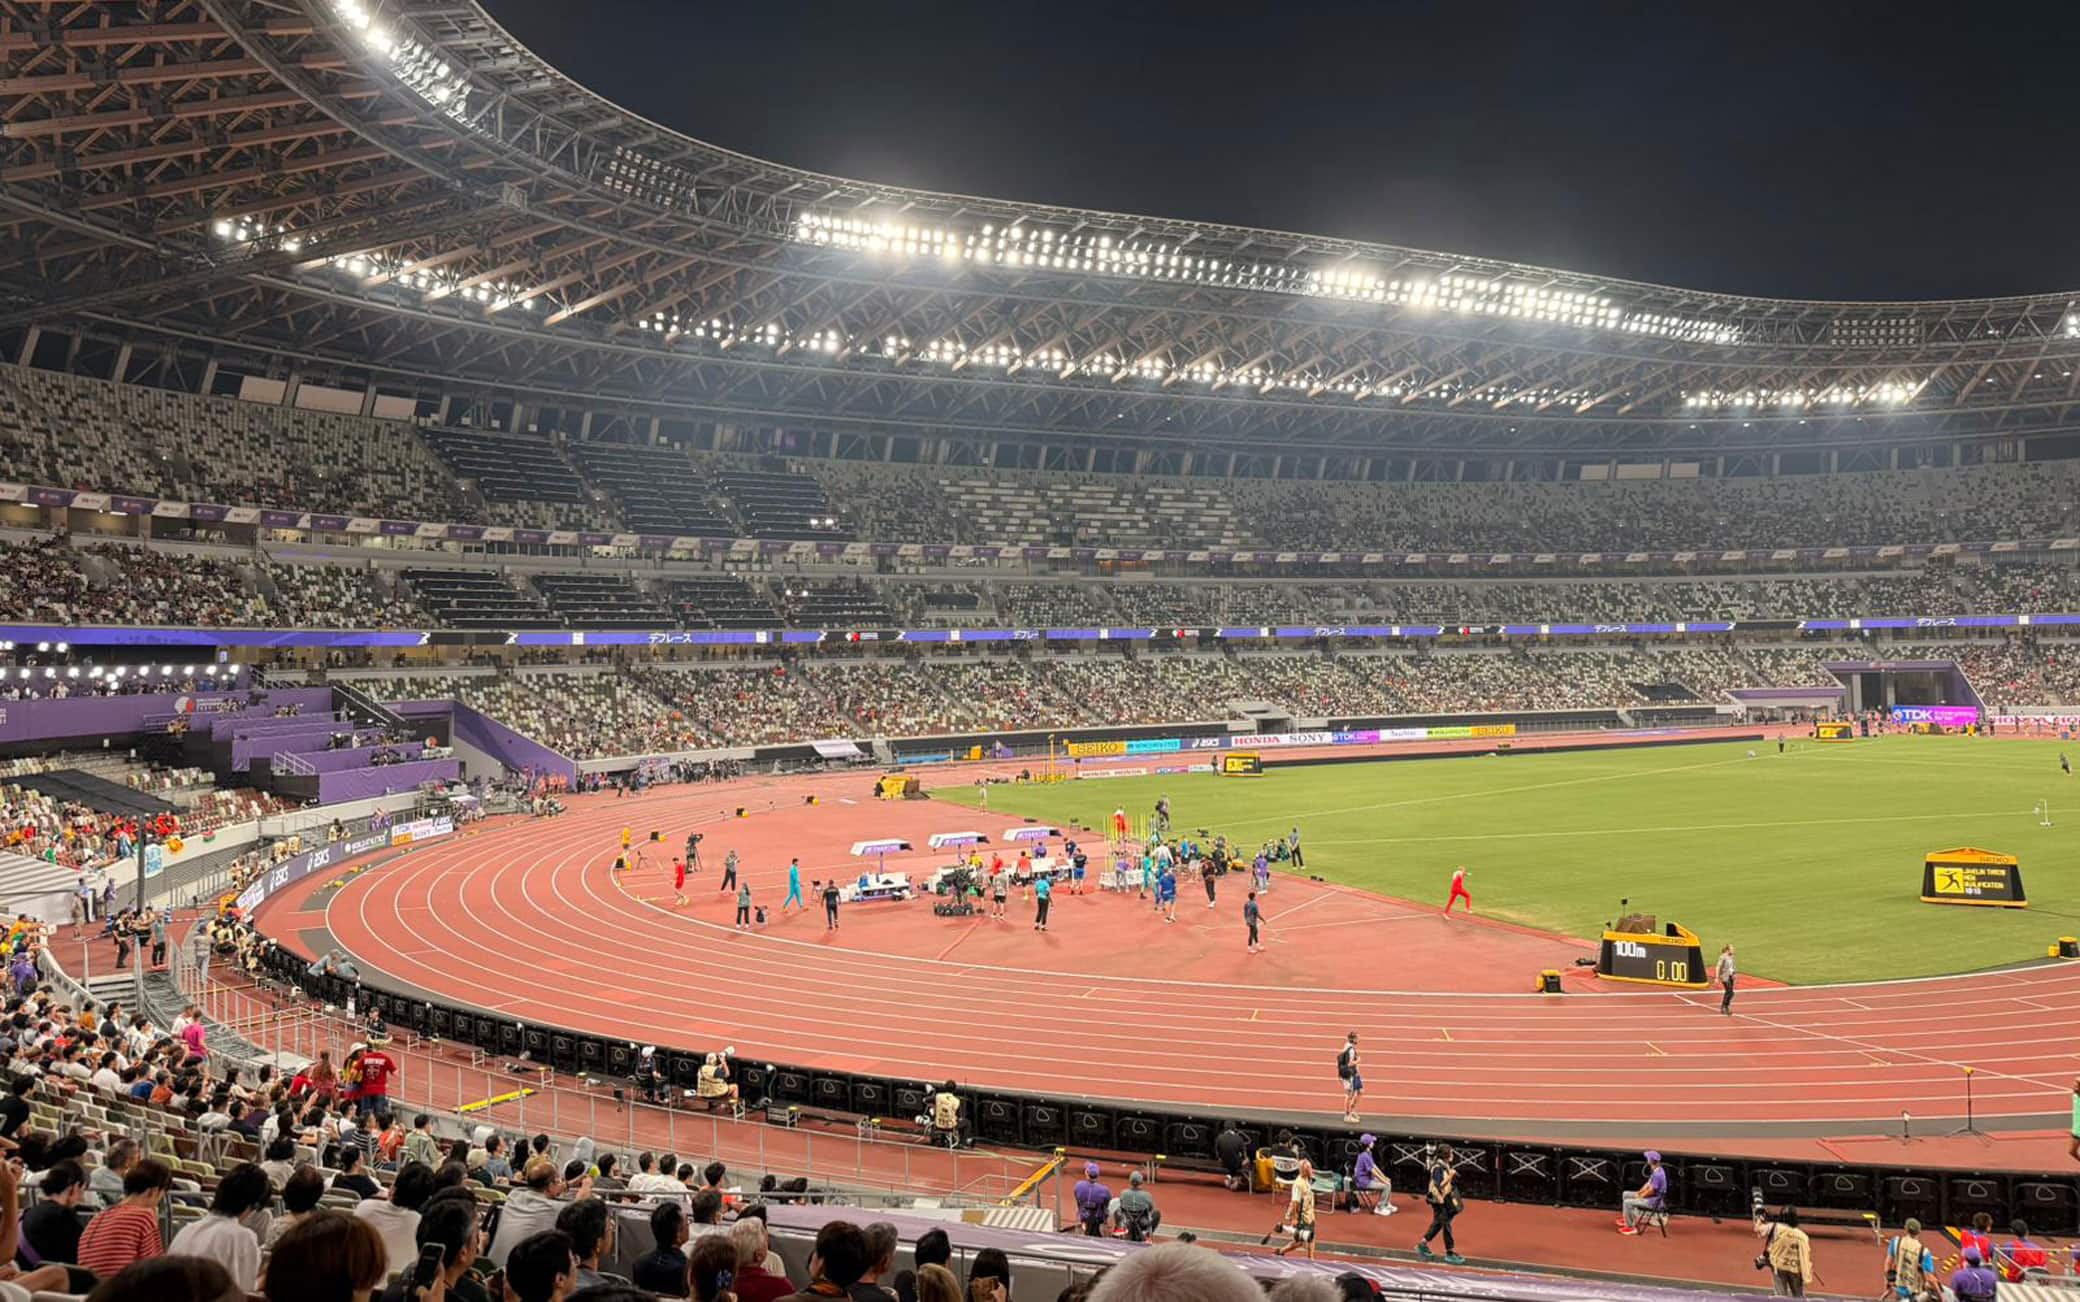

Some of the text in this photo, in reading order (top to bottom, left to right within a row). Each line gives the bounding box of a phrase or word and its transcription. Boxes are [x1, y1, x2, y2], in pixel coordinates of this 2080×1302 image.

[1904, 708, 1933, 720] TDK
[1233, 736, 1281, 746] HONDA
[1288, 734, 1326, 745] SONY
[1077, 742, 1119, 754] SEIKO
[1614, 940, 1647, 958] 100m
[1656, 960, 1687, 981] 0.00
